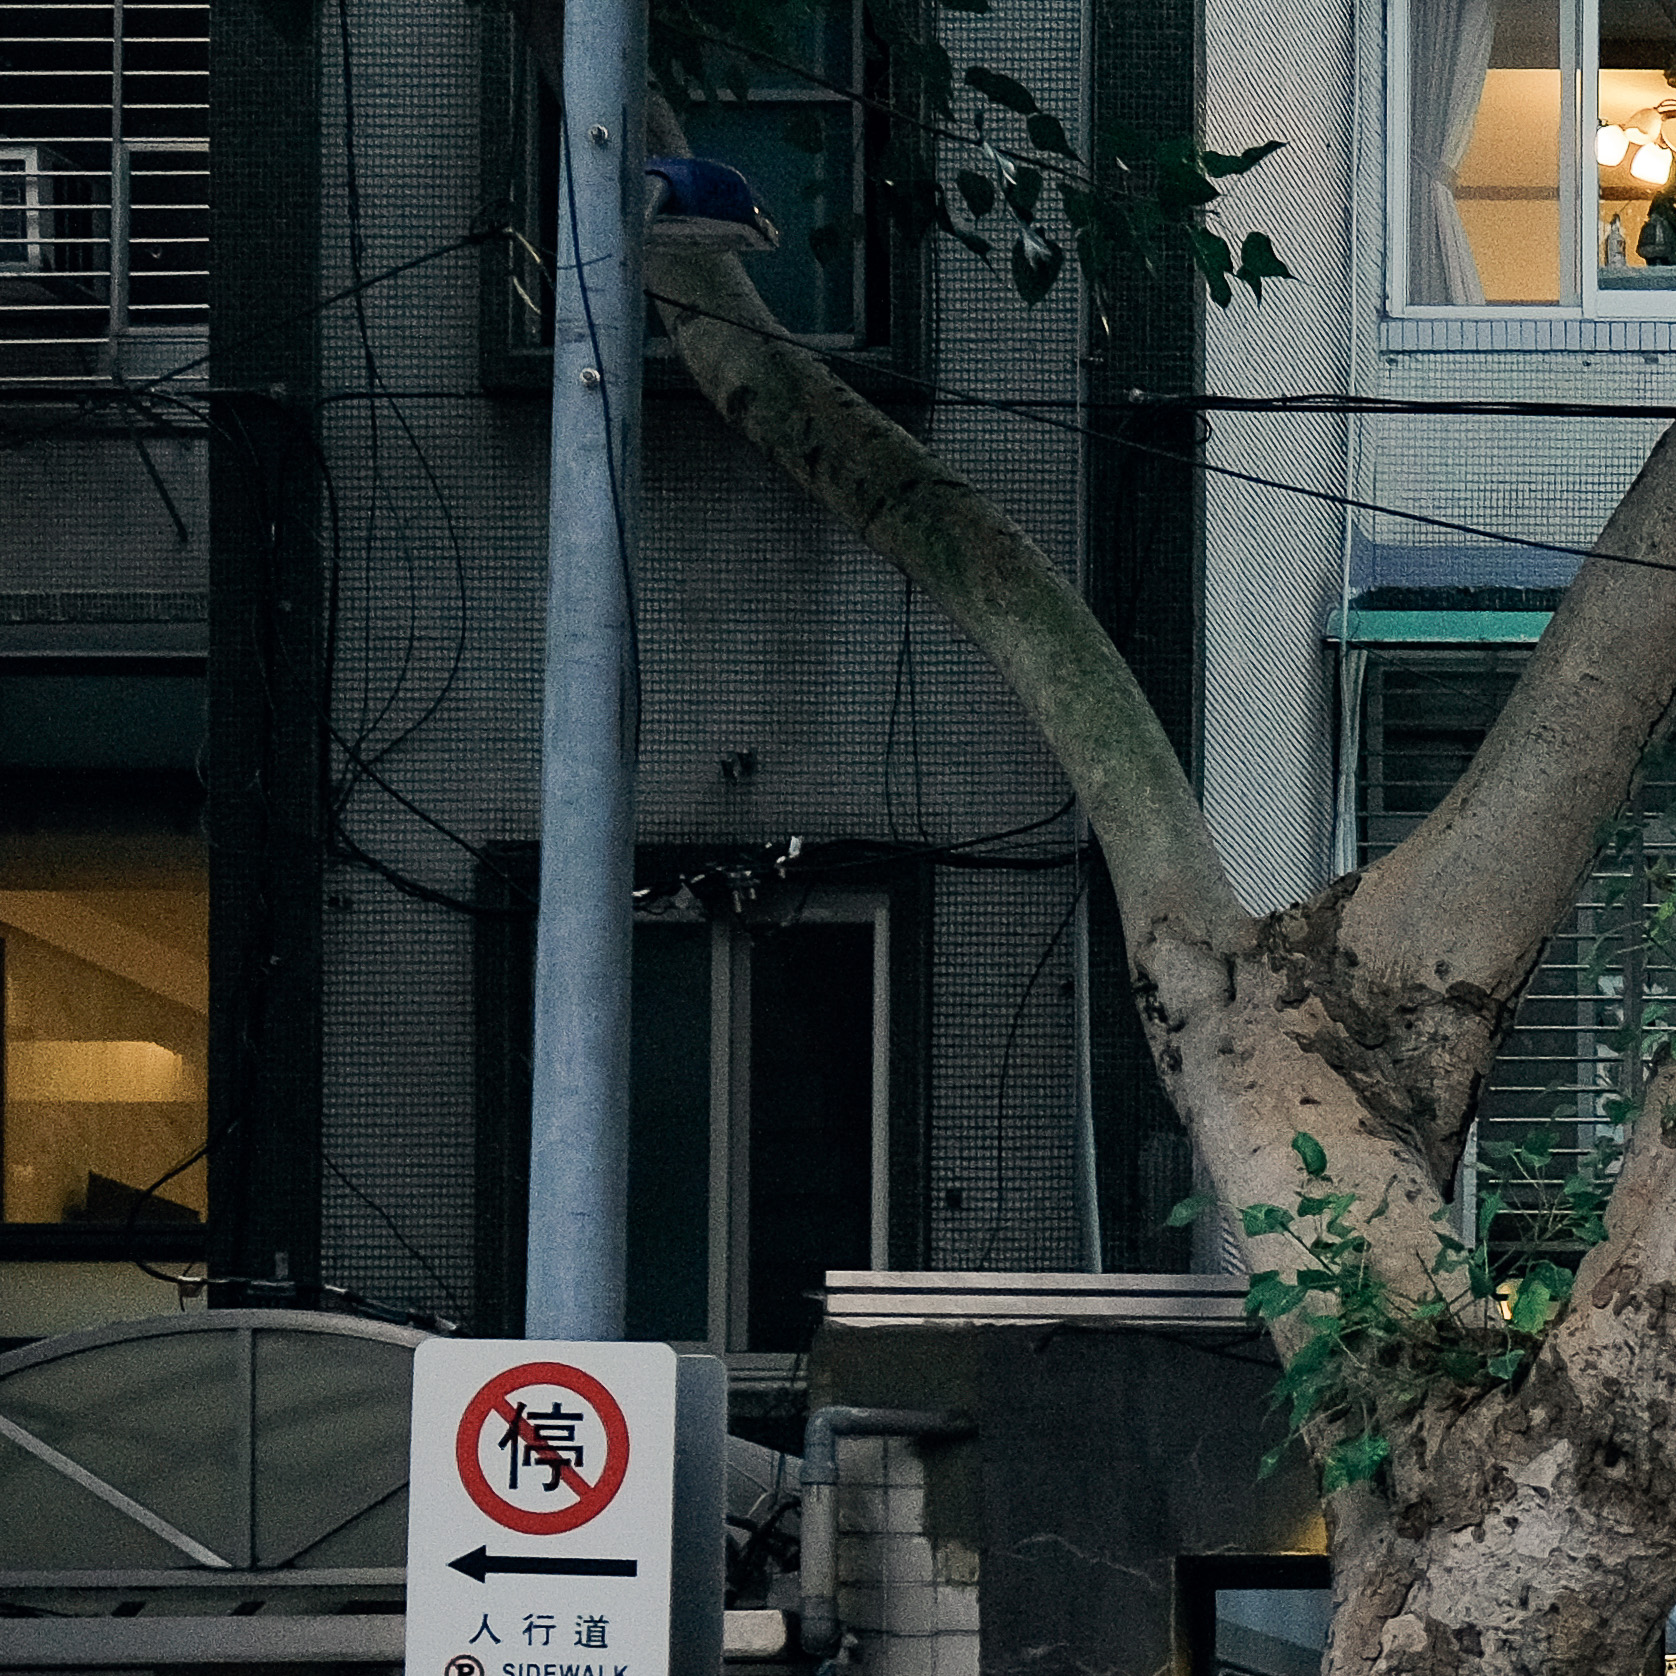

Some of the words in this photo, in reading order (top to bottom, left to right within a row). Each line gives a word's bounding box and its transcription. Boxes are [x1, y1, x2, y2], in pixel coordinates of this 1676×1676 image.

[498, 1402, 585, 1492] 停
[469, 1613, 610, 1649] 人行道
